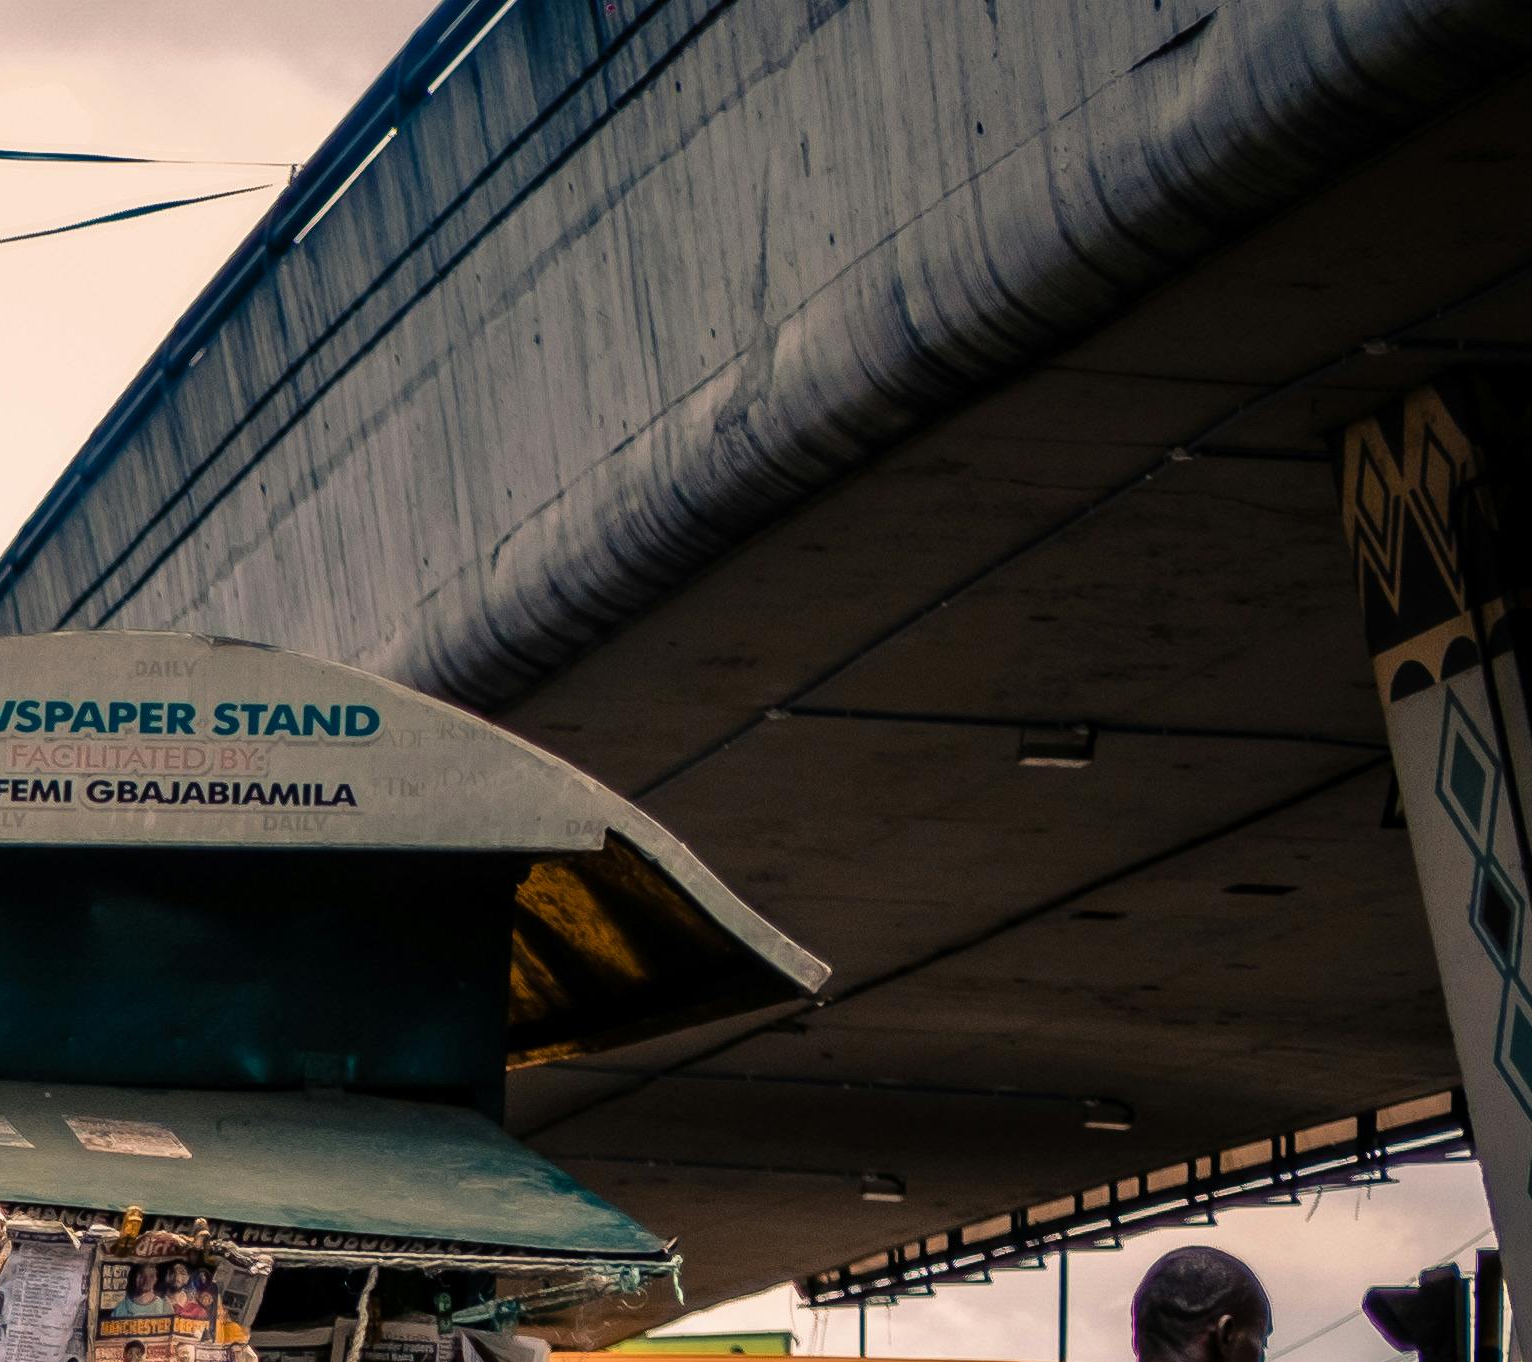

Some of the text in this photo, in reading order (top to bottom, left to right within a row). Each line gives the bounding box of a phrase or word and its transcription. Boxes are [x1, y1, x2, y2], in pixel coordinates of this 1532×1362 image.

[213, 704, 380, 737] STAND
[11, 744, 265, 772] FACILITATED BY:
[86, 779, 358, 807] GBAJABIAMILA
